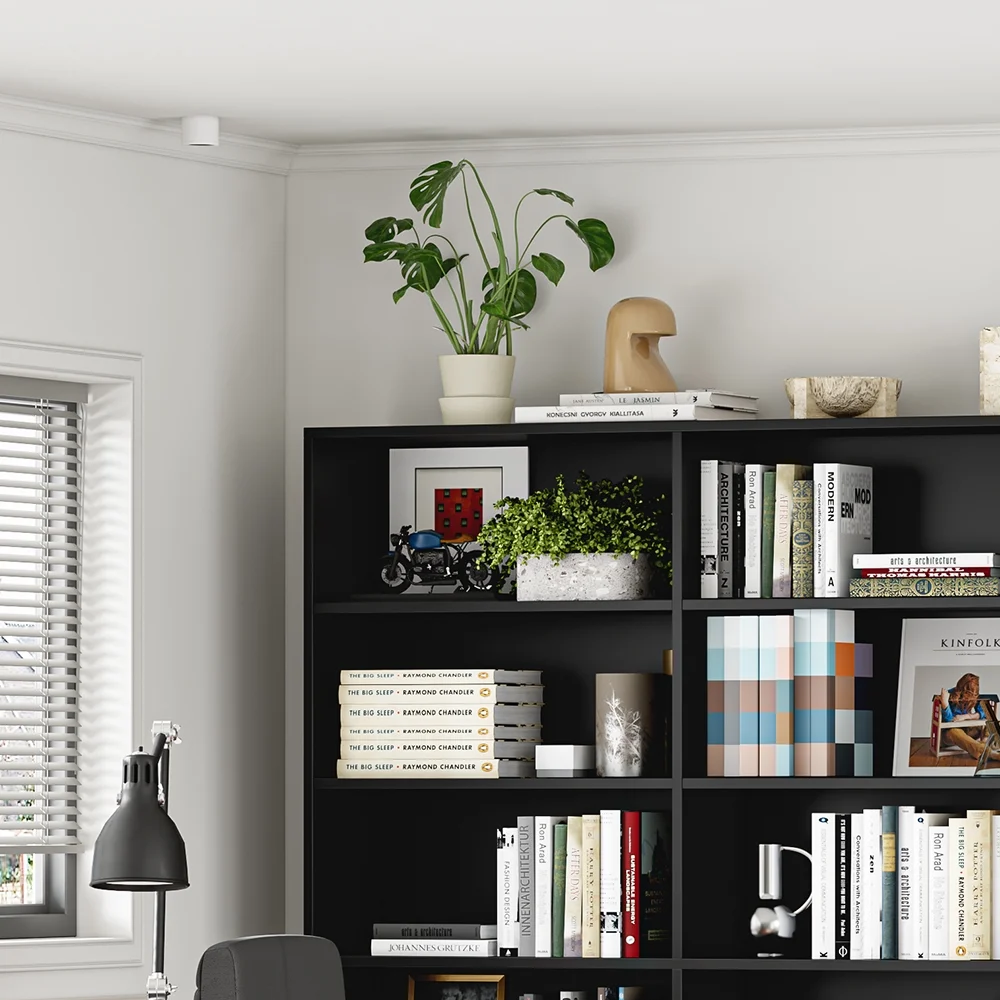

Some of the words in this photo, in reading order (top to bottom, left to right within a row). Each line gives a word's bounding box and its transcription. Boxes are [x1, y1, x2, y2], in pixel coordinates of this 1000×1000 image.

[749, 471, 757, 487] Ron
[749, 490, 757, 509] Arad
[827, 472, 835, 521] MODERN
[855, 487, 871, 504] MOD
[720, 473, 729, 562] ARCHITECTURE
[841, 502, 854, 518] ERN
[539, 823, 547, 840] Ron
[539, 843, 547, 864] Arad
[519, 824, 531, 937] INNENARCHITEKTUR
[388, 944, 437, 952] JOHANNES
